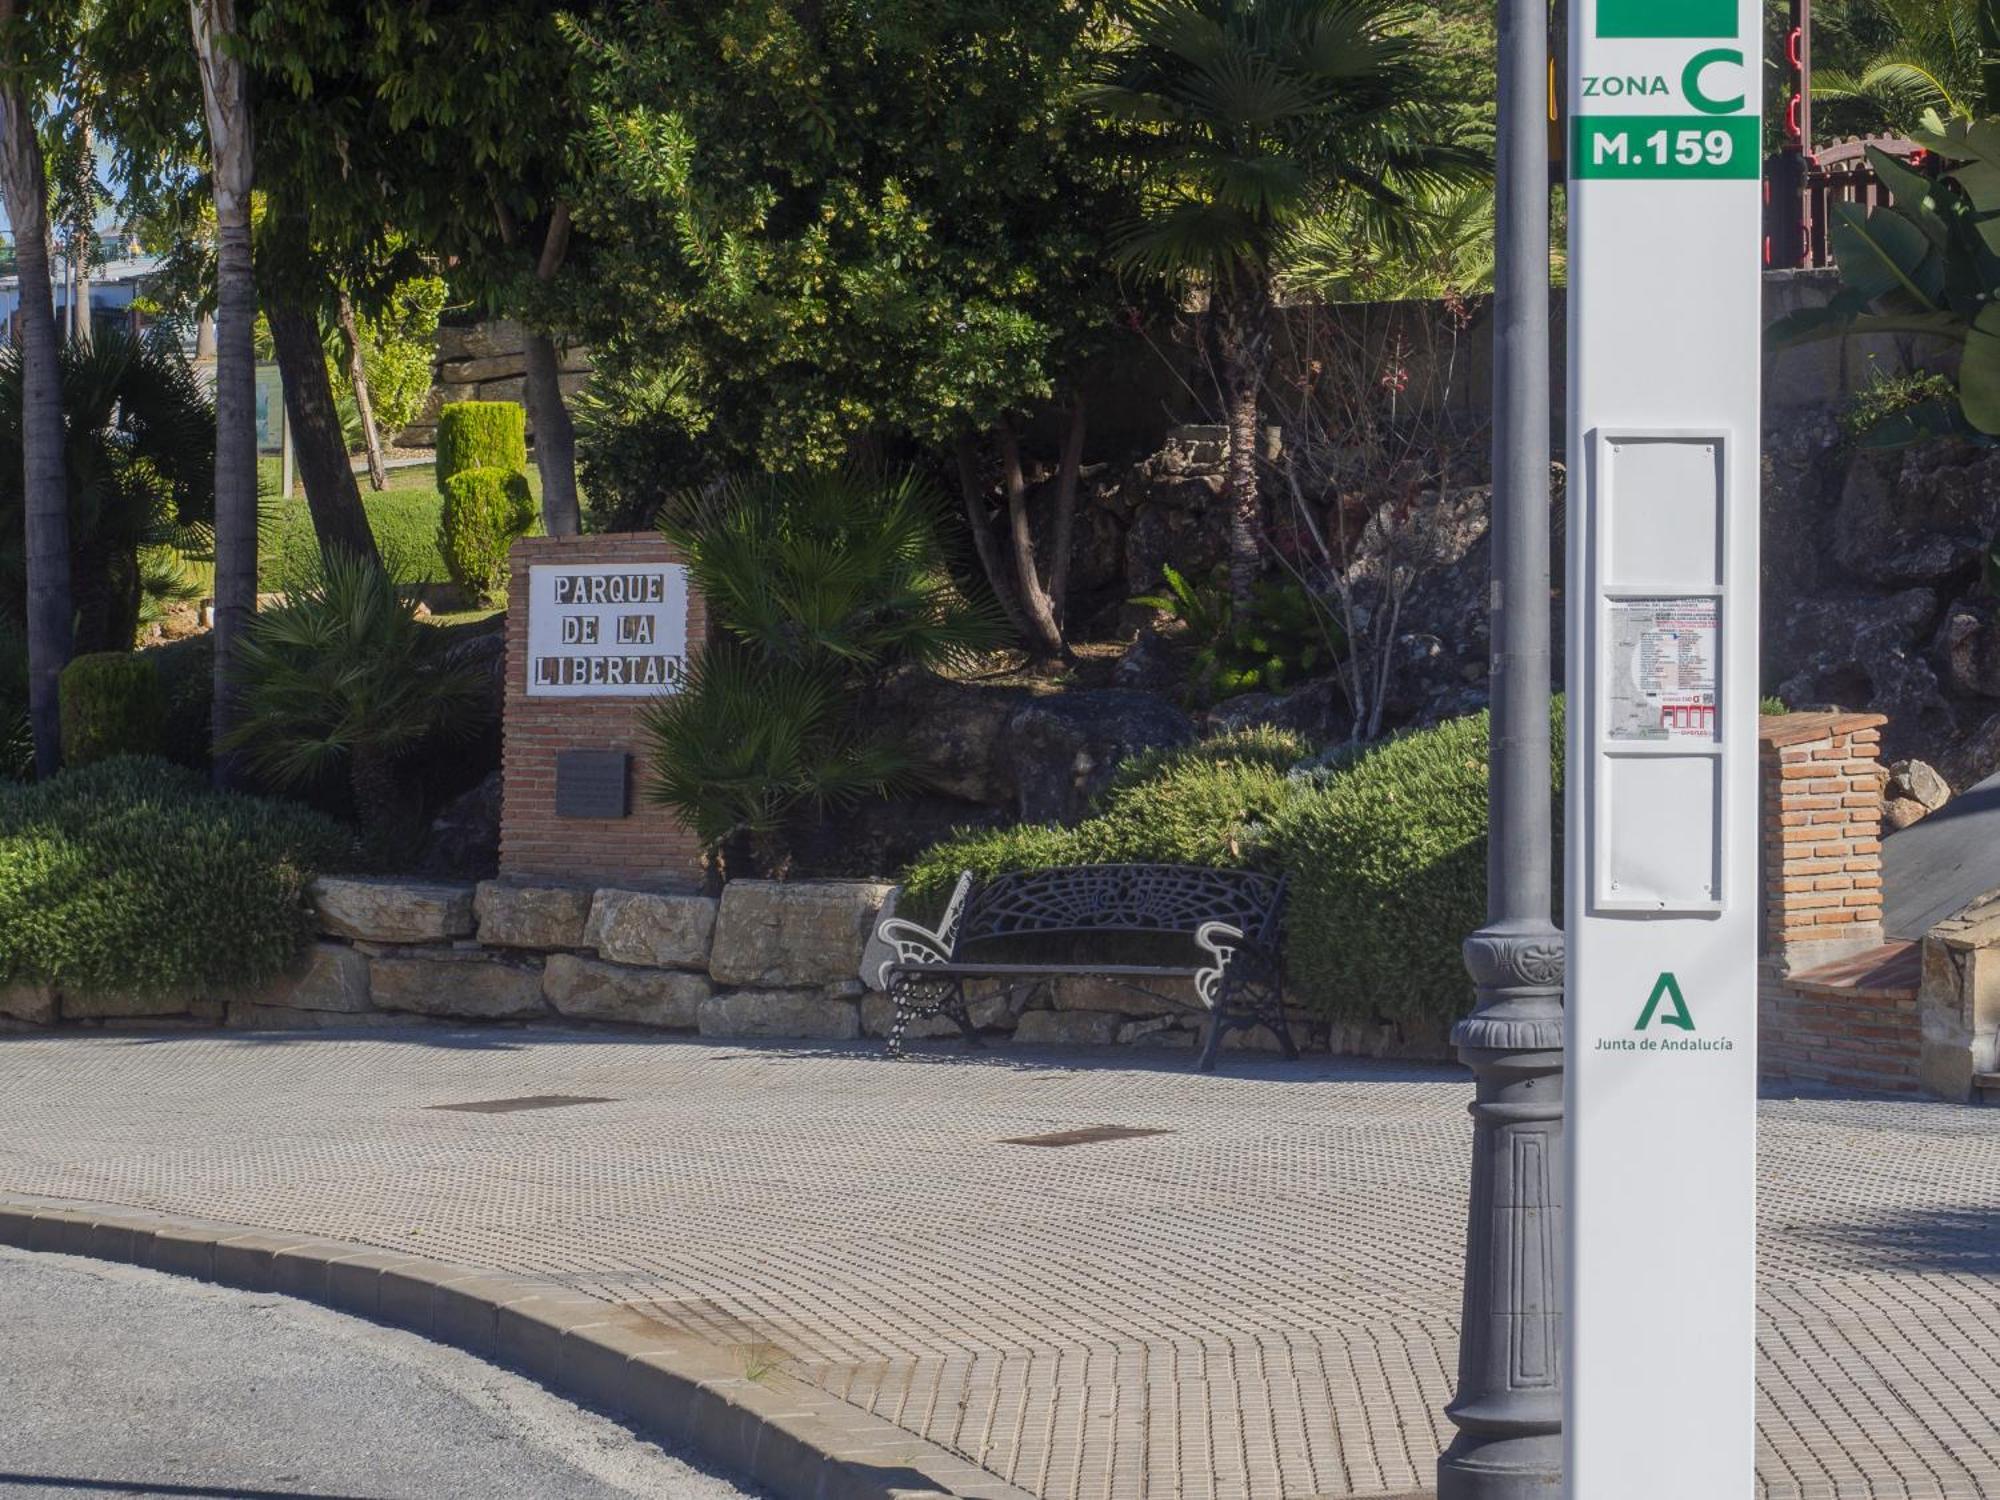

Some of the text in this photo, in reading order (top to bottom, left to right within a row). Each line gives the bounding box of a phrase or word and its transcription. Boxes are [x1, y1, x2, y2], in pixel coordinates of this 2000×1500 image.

[1582, 47, 1745, 115] ZONA C
[1593, 129, 1733, 166] M.159
[553, 575, 662, 604] PARQUE
[563, 615, 654, 644] DE LA
[535, 655, 683, 685] LIBERTAD
[1594, 1036, 1733, 1051] Junta de Andalucía
